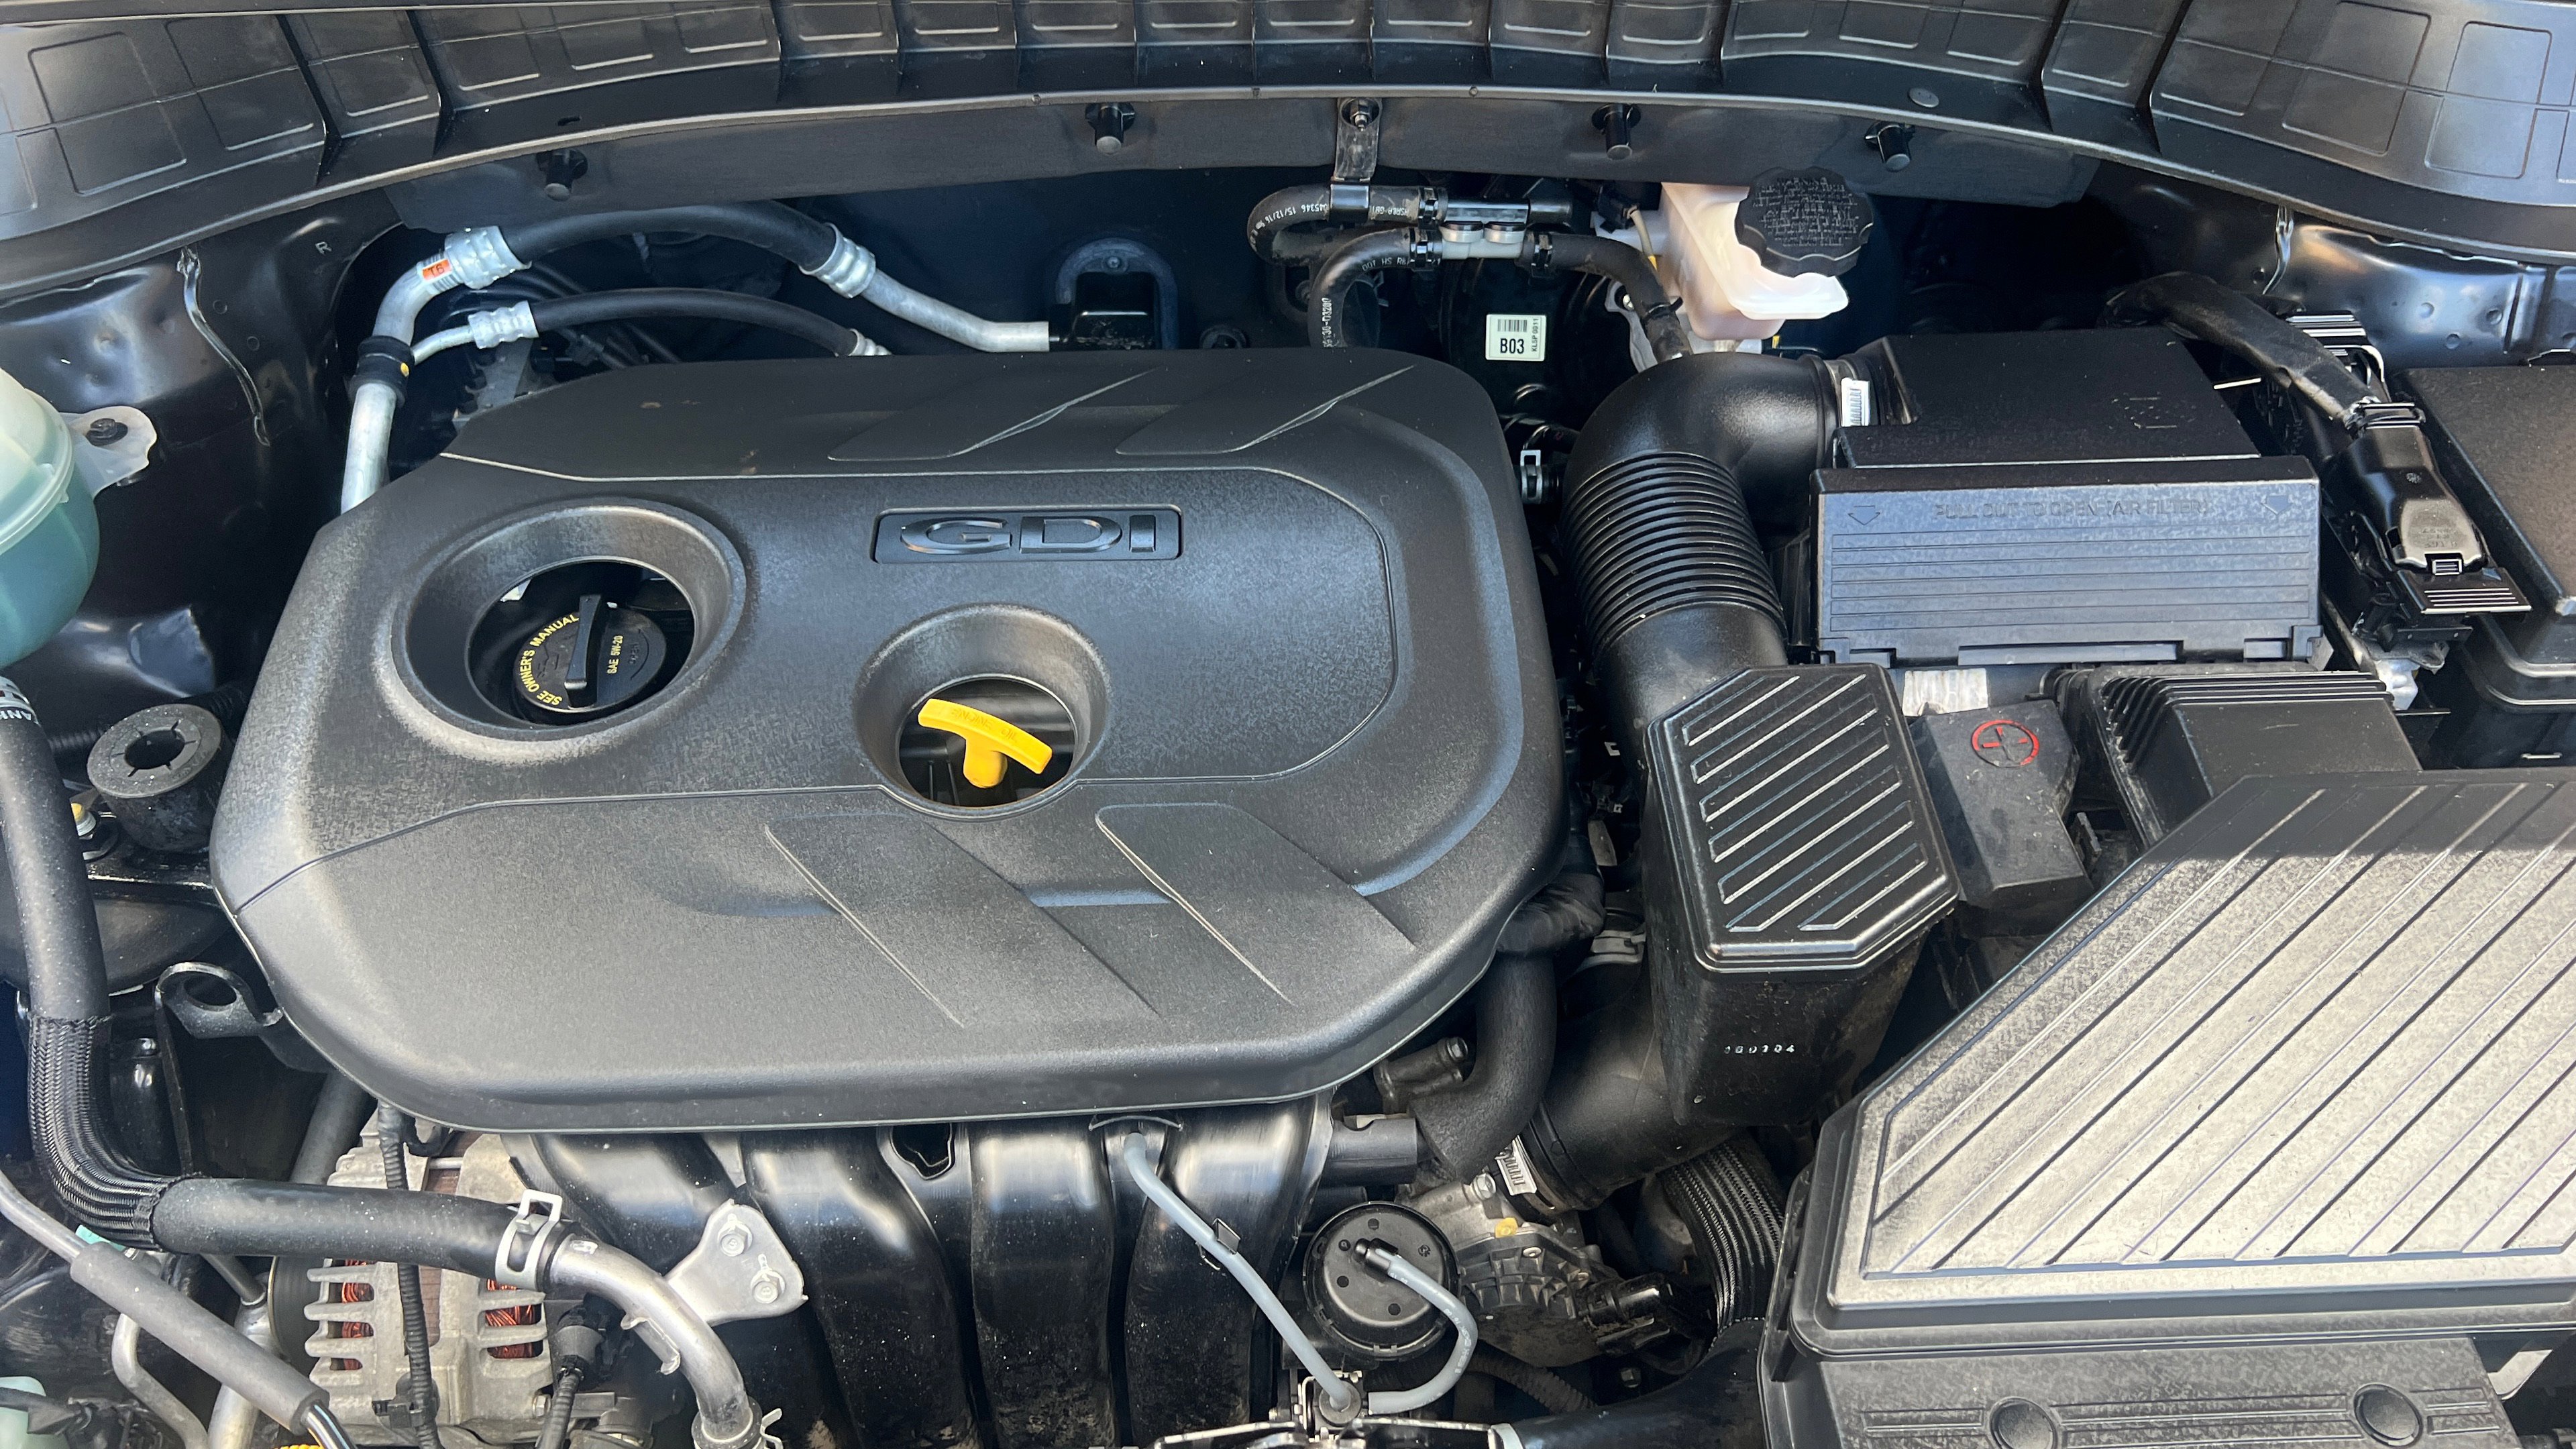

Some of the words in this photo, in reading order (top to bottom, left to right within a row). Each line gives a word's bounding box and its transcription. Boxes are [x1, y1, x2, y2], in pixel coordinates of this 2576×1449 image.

[1500, 337, 1525, 354] B03
[1983, 502, 2020, 518] OUT
[2024, 502, 2047, 517] TO
[900, 515, 1157, 555] GDI
[529, 614, 580, 647] MANUAL
[610, 635, 624, 656] 5W-20
[519, 649, 541, 693] OWNER'S
[607, 659, 619, 675] SAE
[537, 690, 563, 706] SEE
[950, 708, 994, 731] ENGINE
[1000, 728, 1018, 743] OIL
